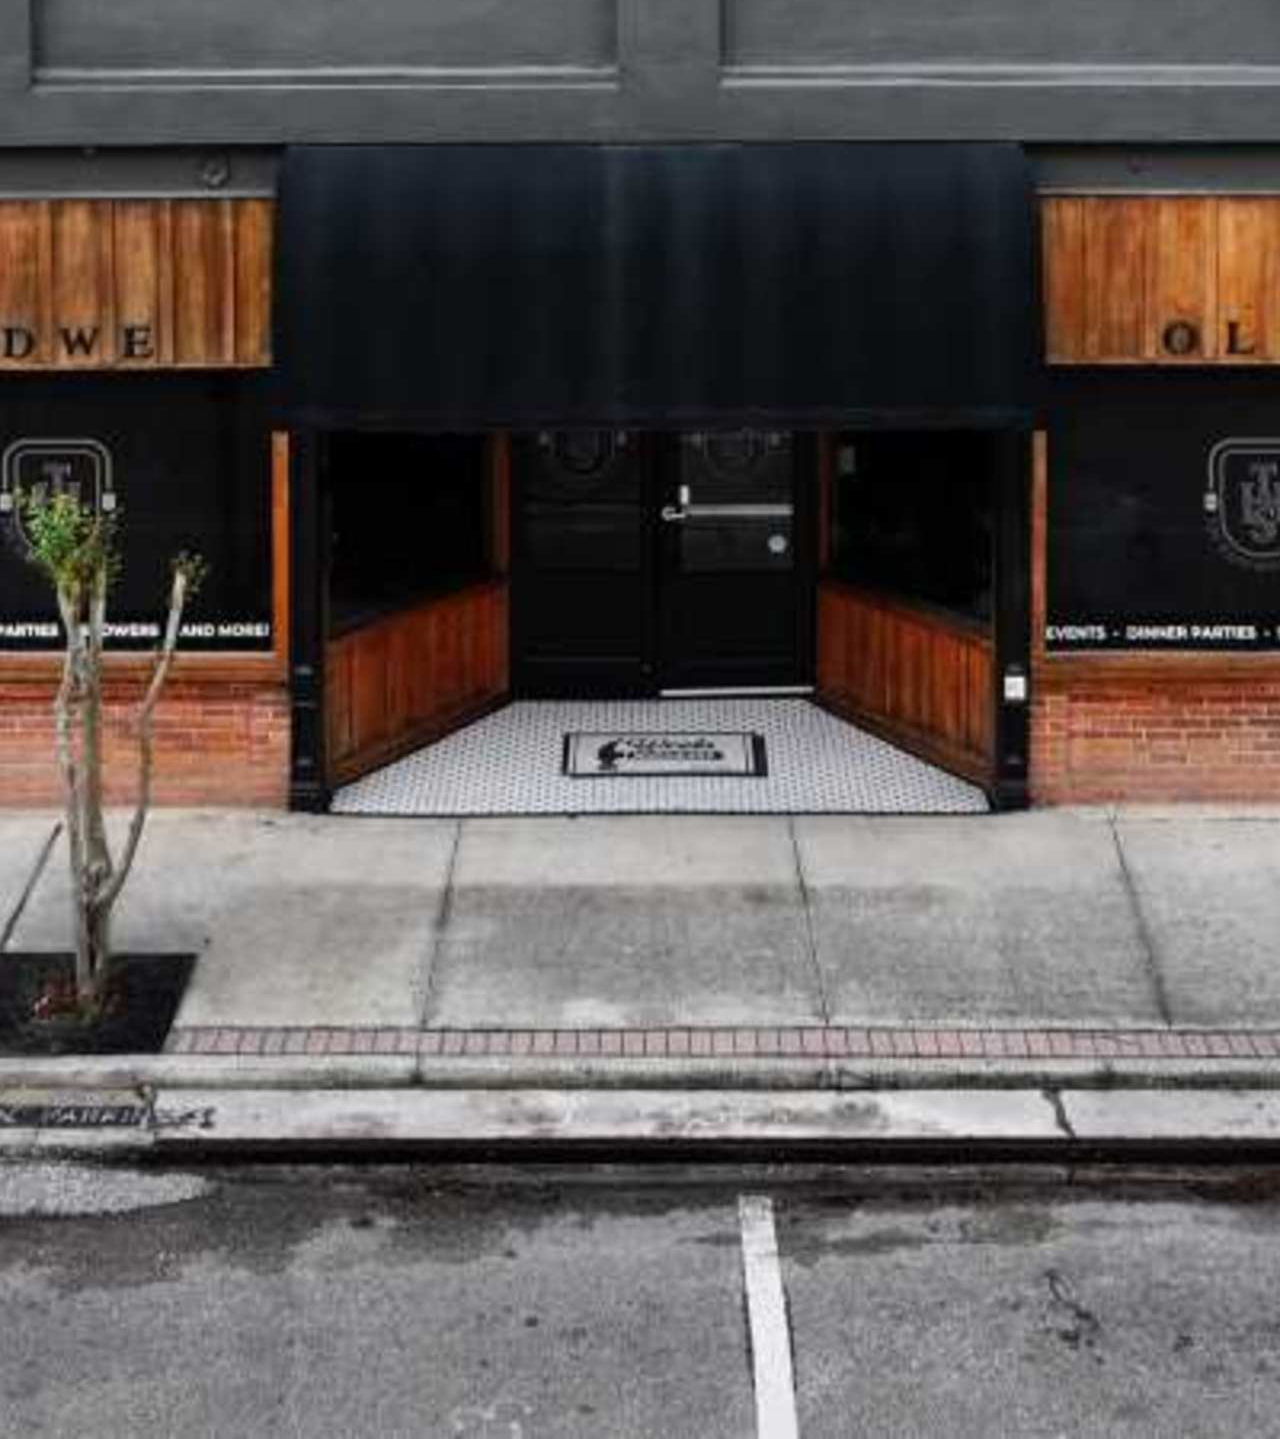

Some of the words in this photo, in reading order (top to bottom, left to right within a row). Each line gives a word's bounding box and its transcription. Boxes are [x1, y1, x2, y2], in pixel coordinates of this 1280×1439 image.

[179, 622, 215, 638] AND
[218, 622, 270, 638] MORE!
[1045, 624, 1107, 640] EVENTS
[1126, 624, 1188, 640] DINNER
[1191, 624, 1257, 640] PARTIES
